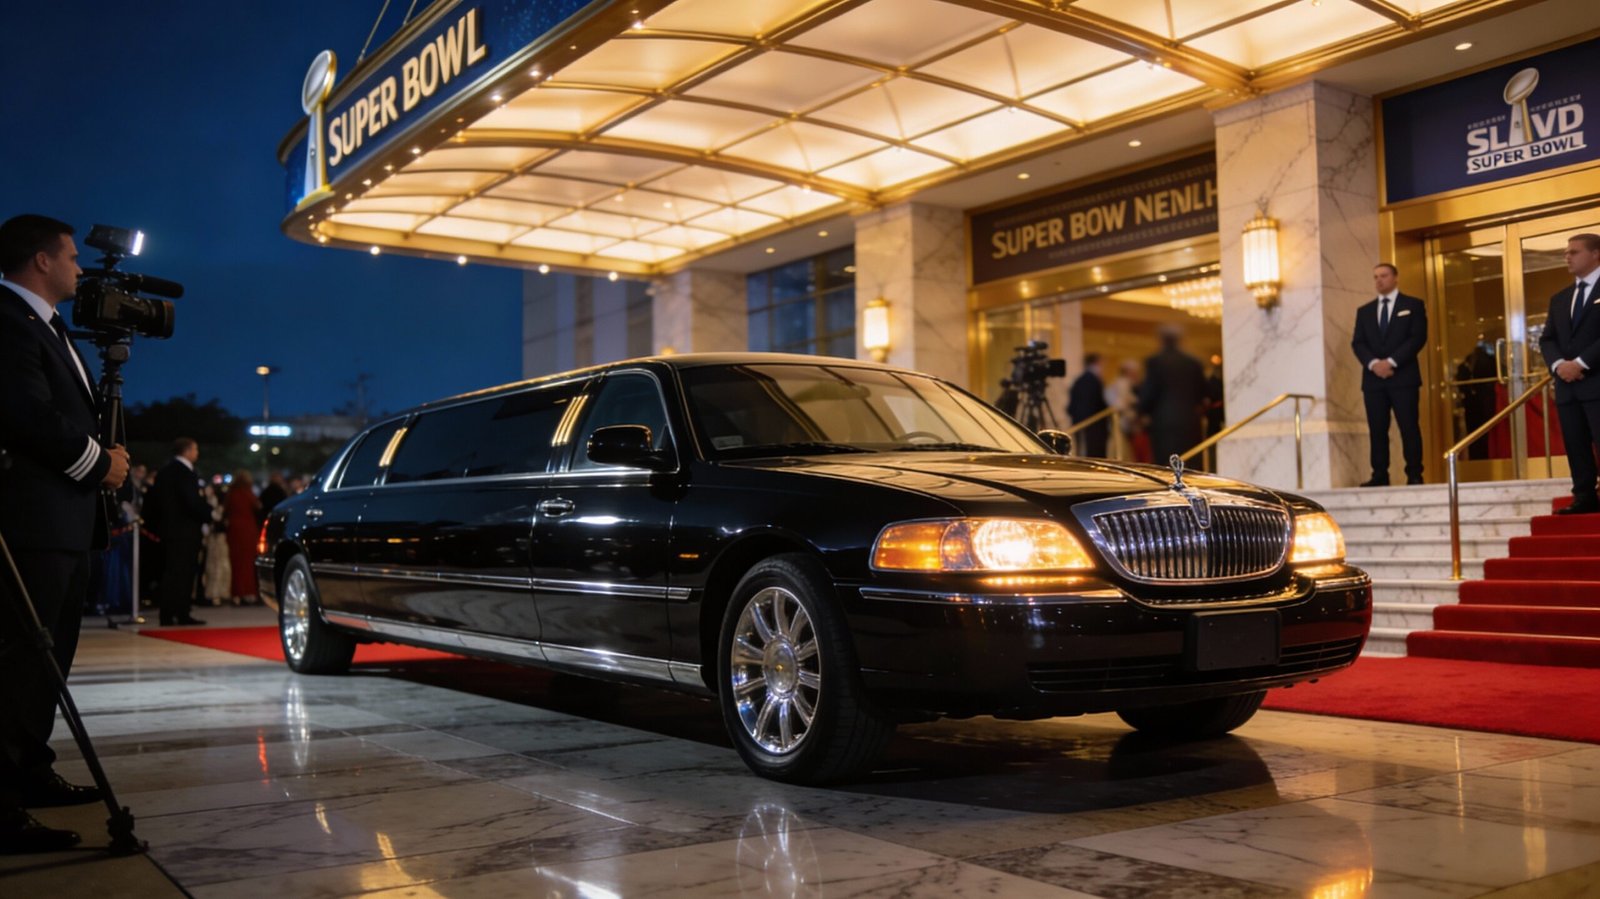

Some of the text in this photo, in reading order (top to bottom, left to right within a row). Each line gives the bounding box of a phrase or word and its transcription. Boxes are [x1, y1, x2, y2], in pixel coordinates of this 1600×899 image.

[328, 9, 486, 166] SUPER BOWL
[1472, 137, 1580, 171] SUPER BOWL
[992, 219, 1065, 260] SUPER
[1070, 202, 1126, 241] BOW
